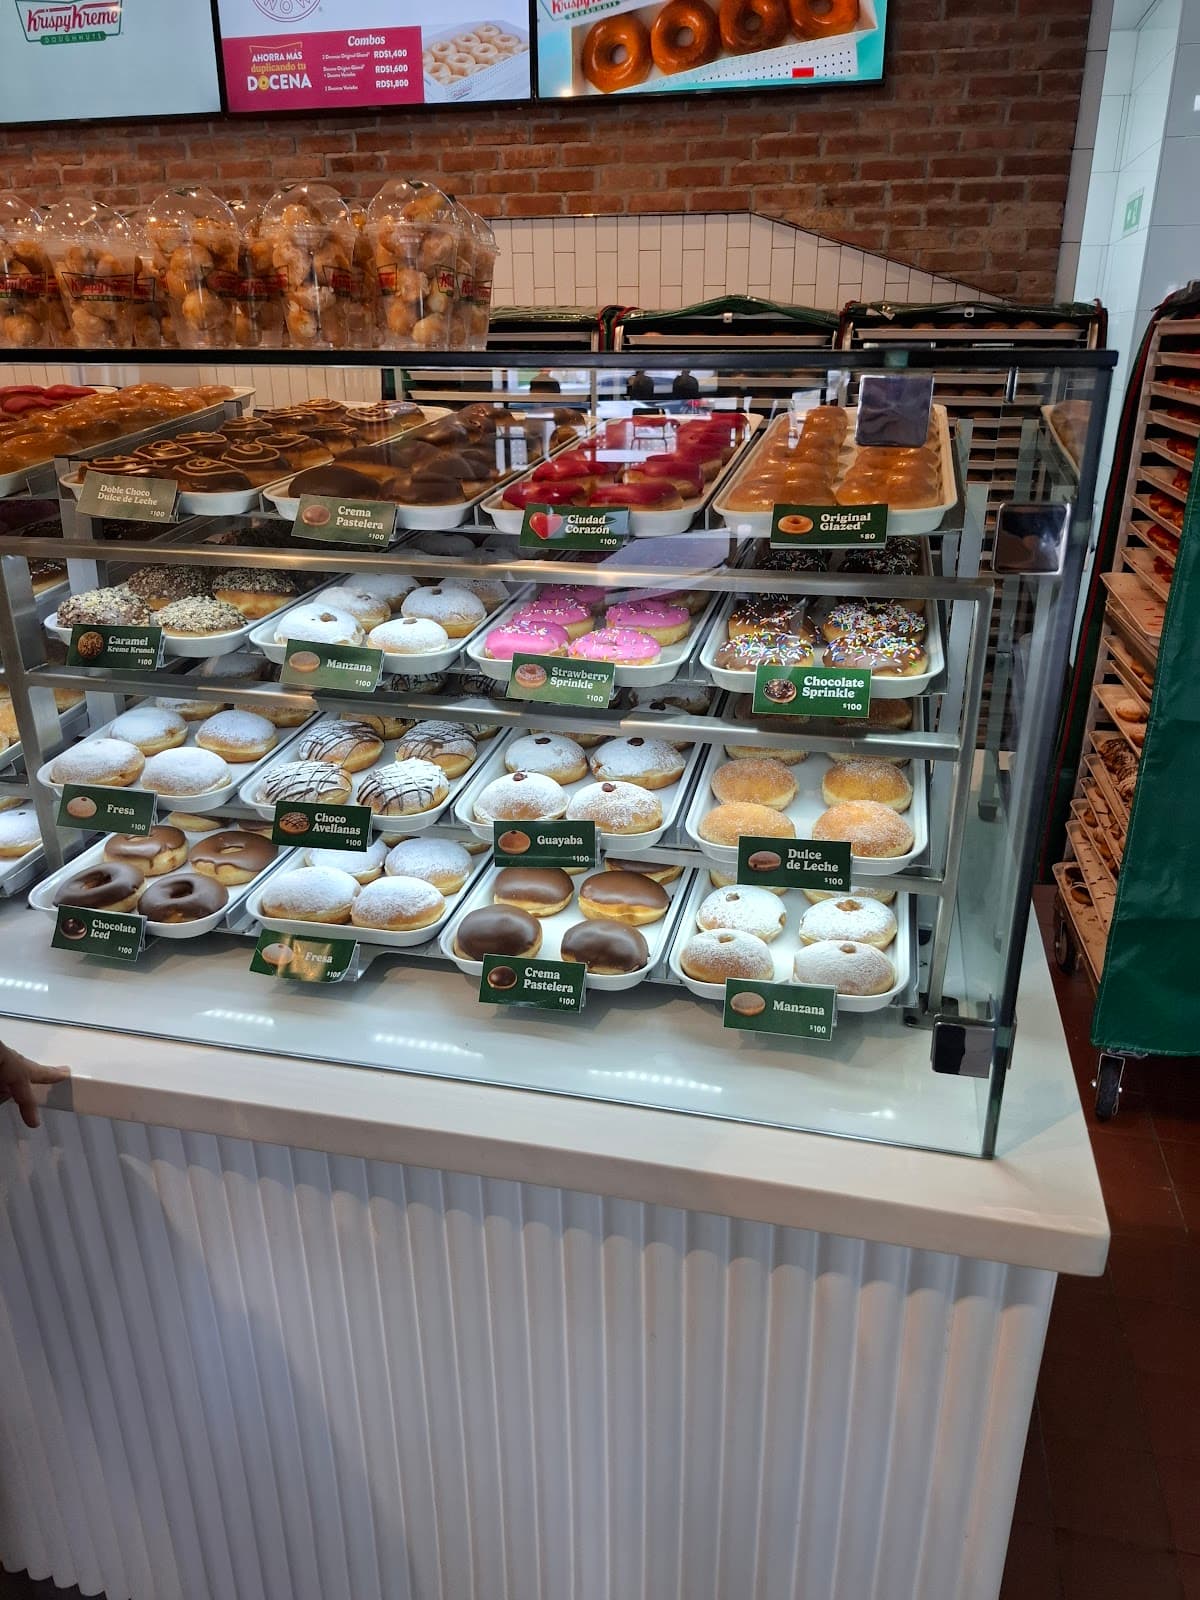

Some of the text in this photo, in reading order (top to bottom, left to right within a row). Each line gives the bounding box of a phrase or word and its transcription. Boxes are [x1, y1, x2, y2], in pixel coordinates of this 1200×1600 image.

[27, 1, 120, 33] Krispy Kreme
[347, 34, 386, 46] Combos
[252, 52, 285, 62] AHORRA
[251, 62, 307, 74] duplicando tu
[247, 73, 312, 91] DOCENA
[100, 484, 151, 497] Doble Choco
[97, 492, 122, 502] Dulce
[134, 497, 158, 506] Leche
[337, 505, 371, 517] Crema
[335, 516, 384, 530] Pastelera
[567, 514, 606, 525] Ciudad
[820, 512, 872, 524] Original
[565, 524, 610, 535] Corazón
[368, 533, 385, 541] $100
[108, 635, 149, 646] Caramel
[107, 645, 155, 655] Kreme Krunch
[137, 658, 153, 666] $100
[326, 658, 373, 673] Manzana
[551, 666, 610, 684] Strawberry
[355, 679, 372, 687] $100
[550, 676, 594, 690] Sprinkle
[803, 675, 865, 688] Chocolate
[586, 694, 604, 703] $100
[801, 686, 856, 699] Sprinkle
[842, 703, 863, 711] $100
[106, 803, 136, 816] Fresa
[314, 812, 347, 824] Choco
[311, 823, 361, 835] Avellanas
[345, 839, 362, 847] $100
[536, 835, 584, 848] Guayaba
[572, 855, 590, 863] $100
[787, 848, 823, 860] Dulce
[786, 860, 839, 873] de Leche
[824, 878, 844, 886] $100
[92, 919, 137, 934] Chocolate
[90, 929, 111, 940] Iced
[304, 951, 334, 964] Fresa
[524, 967, 561, 980] Crema
[523, 979, 574, 994] Pastelera
[559, 998, 576, 1006] $100
[772, 999, 825, 1016] Manzana
[809, 1025, 827, 1034] $100
